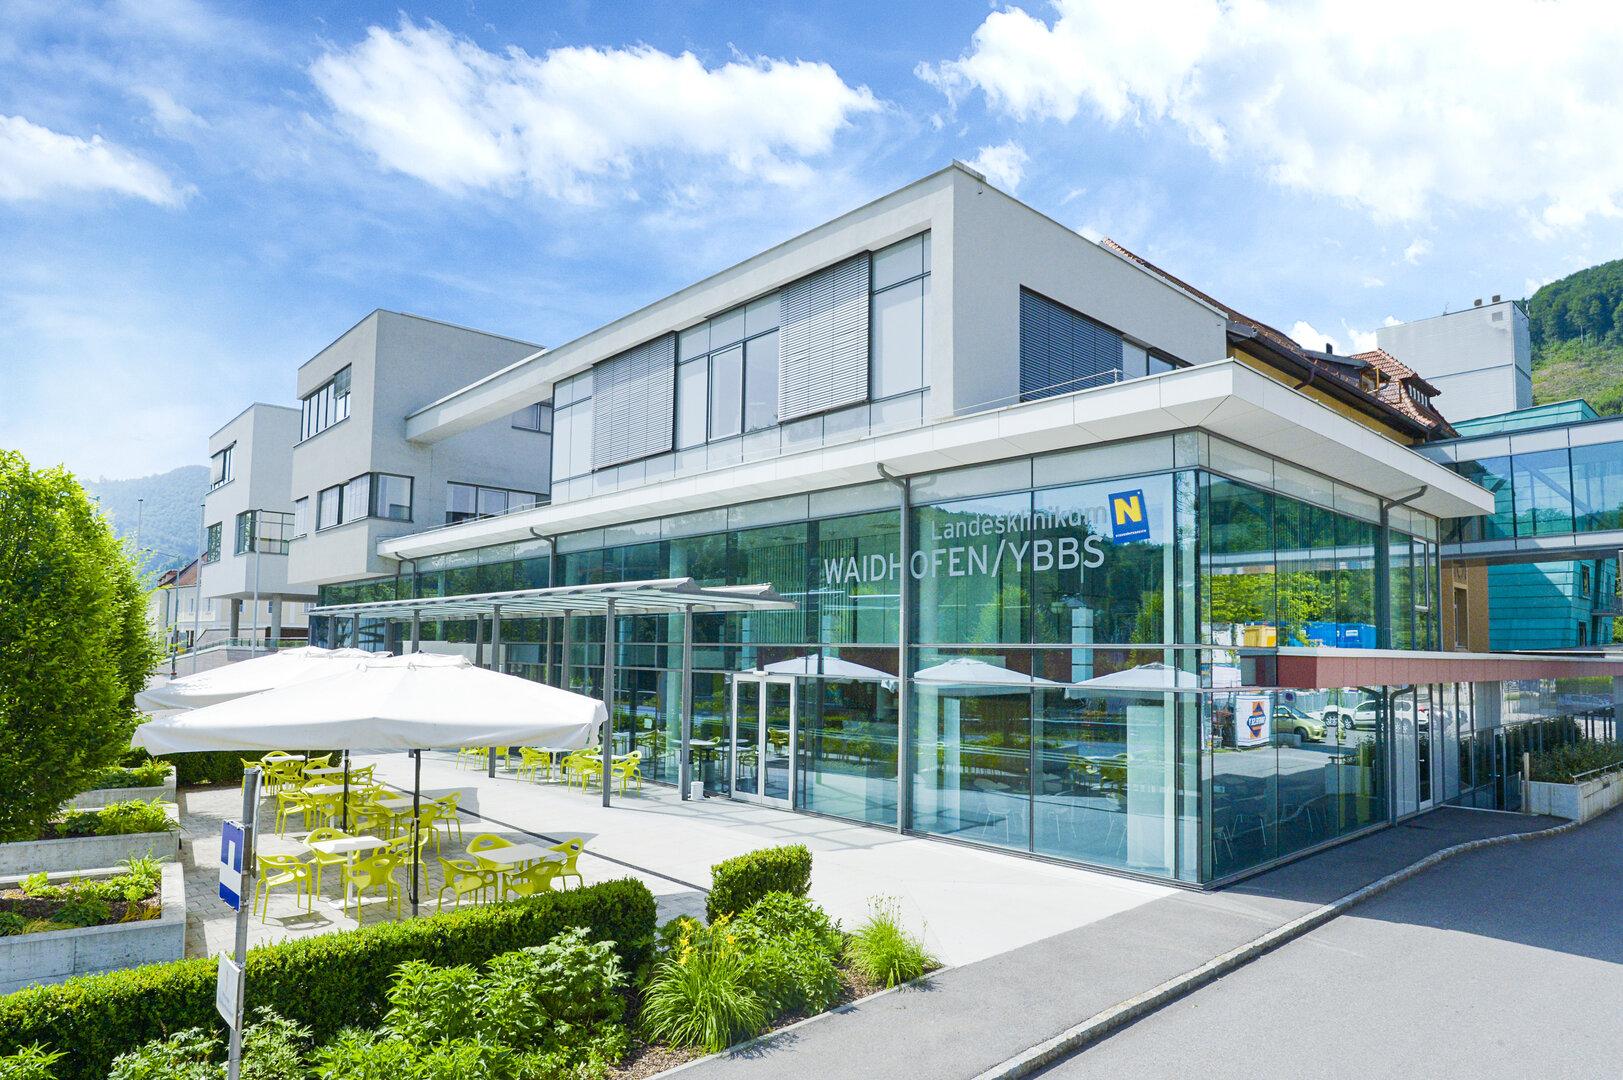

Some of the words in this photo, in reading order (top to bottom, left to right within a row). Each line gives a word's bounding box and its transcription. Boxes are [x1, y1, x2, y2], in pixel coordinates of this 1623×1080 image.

[931, 504, 1107, 541] Landesklinikum
[1114, 495, 1143, 526] N
[824, 534, 1105, 584] WAIDHOFEN/YBBS
